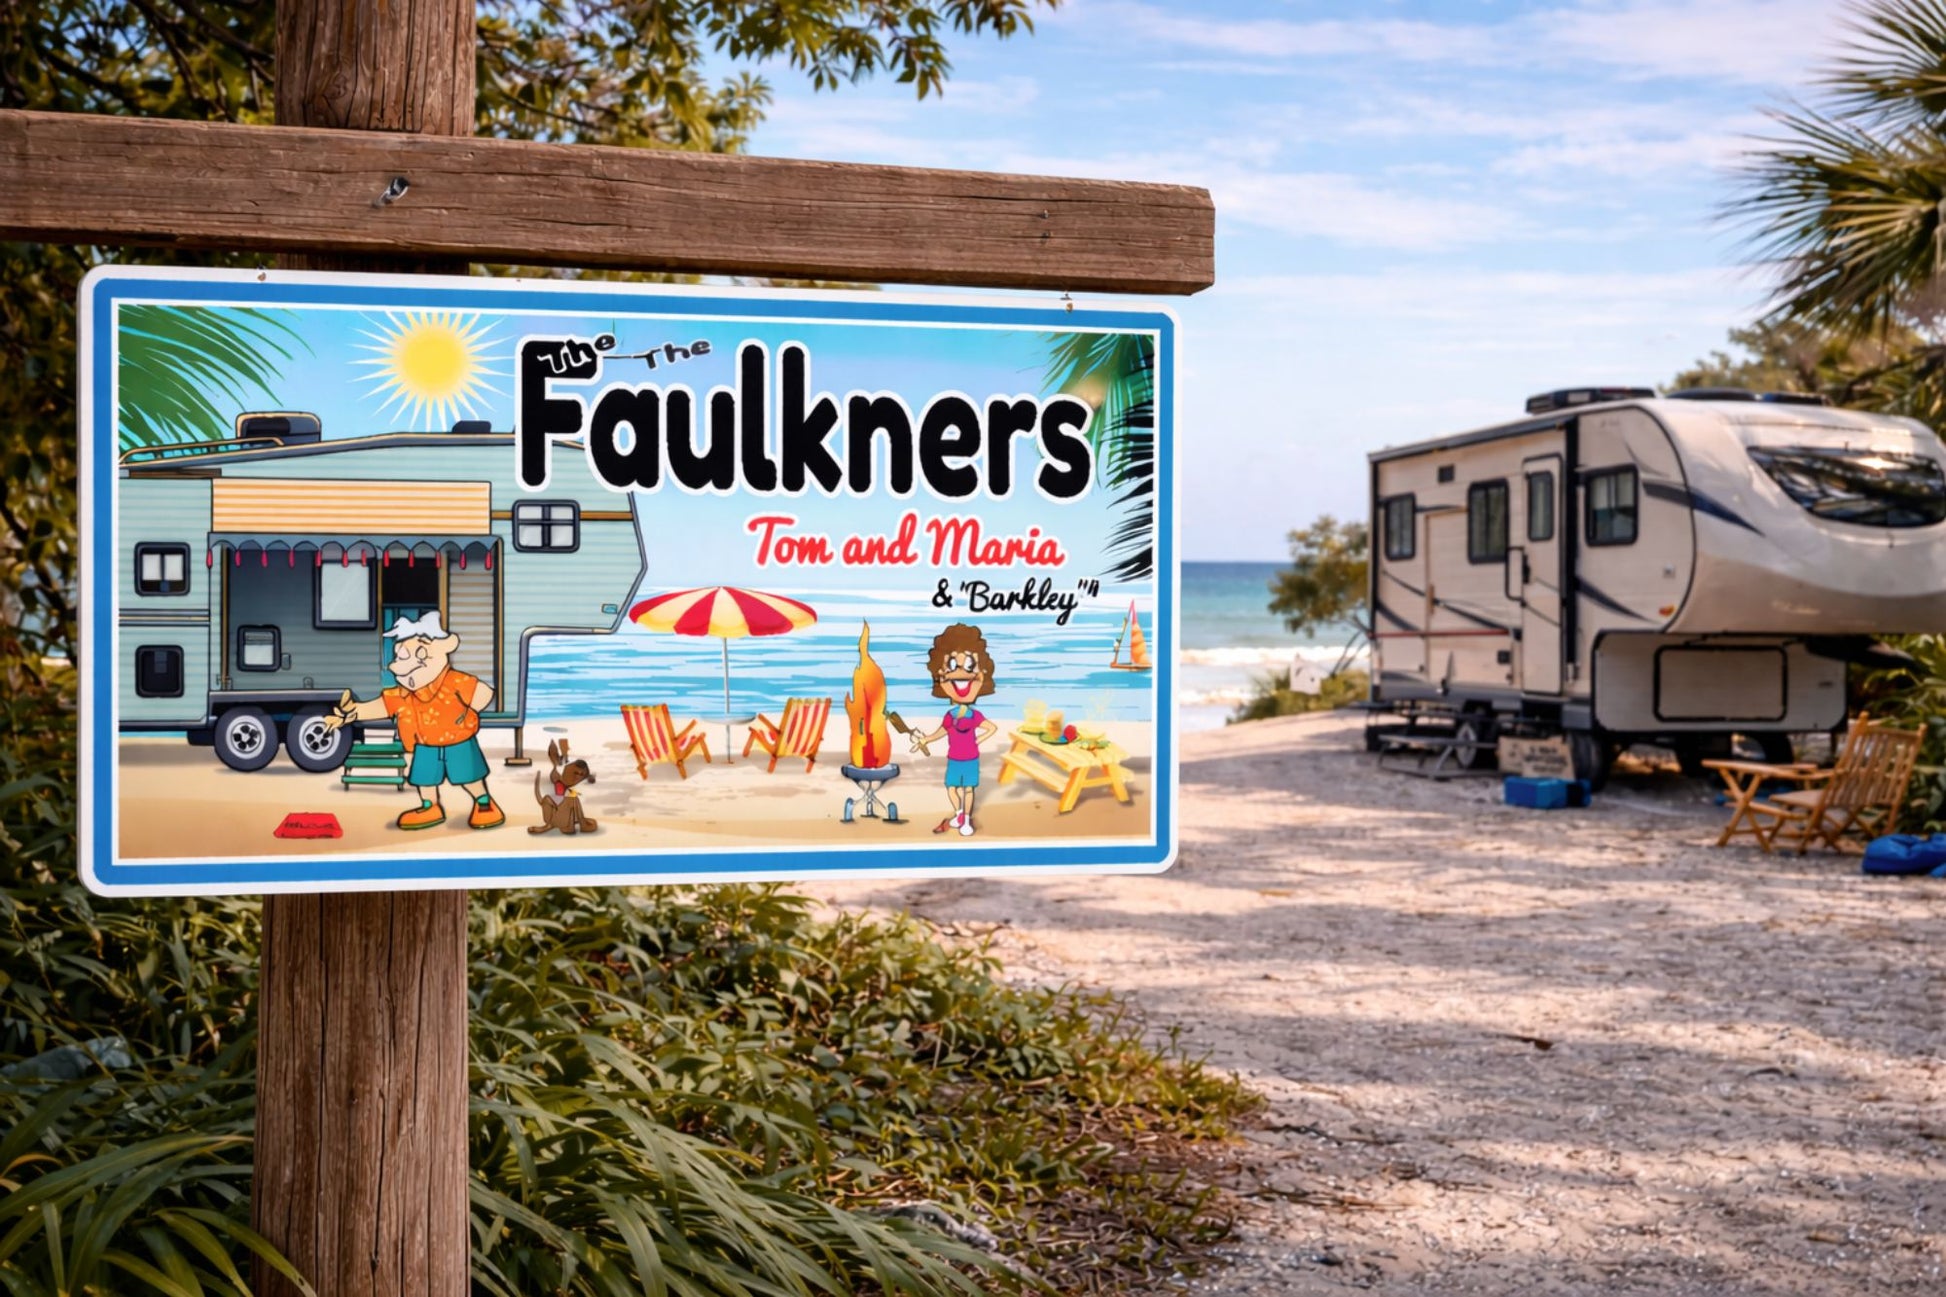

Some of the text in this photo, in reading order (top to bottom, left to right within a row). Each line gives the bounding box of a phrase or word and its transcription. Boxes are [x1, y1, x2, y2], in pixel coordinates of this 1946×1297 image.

[634, 340, 711, 369] The
[521, 341, 1092, 498] Faulkners
[748, 513, 1065, 566] Tom and Maria
[932, 578, 953, 608] &
